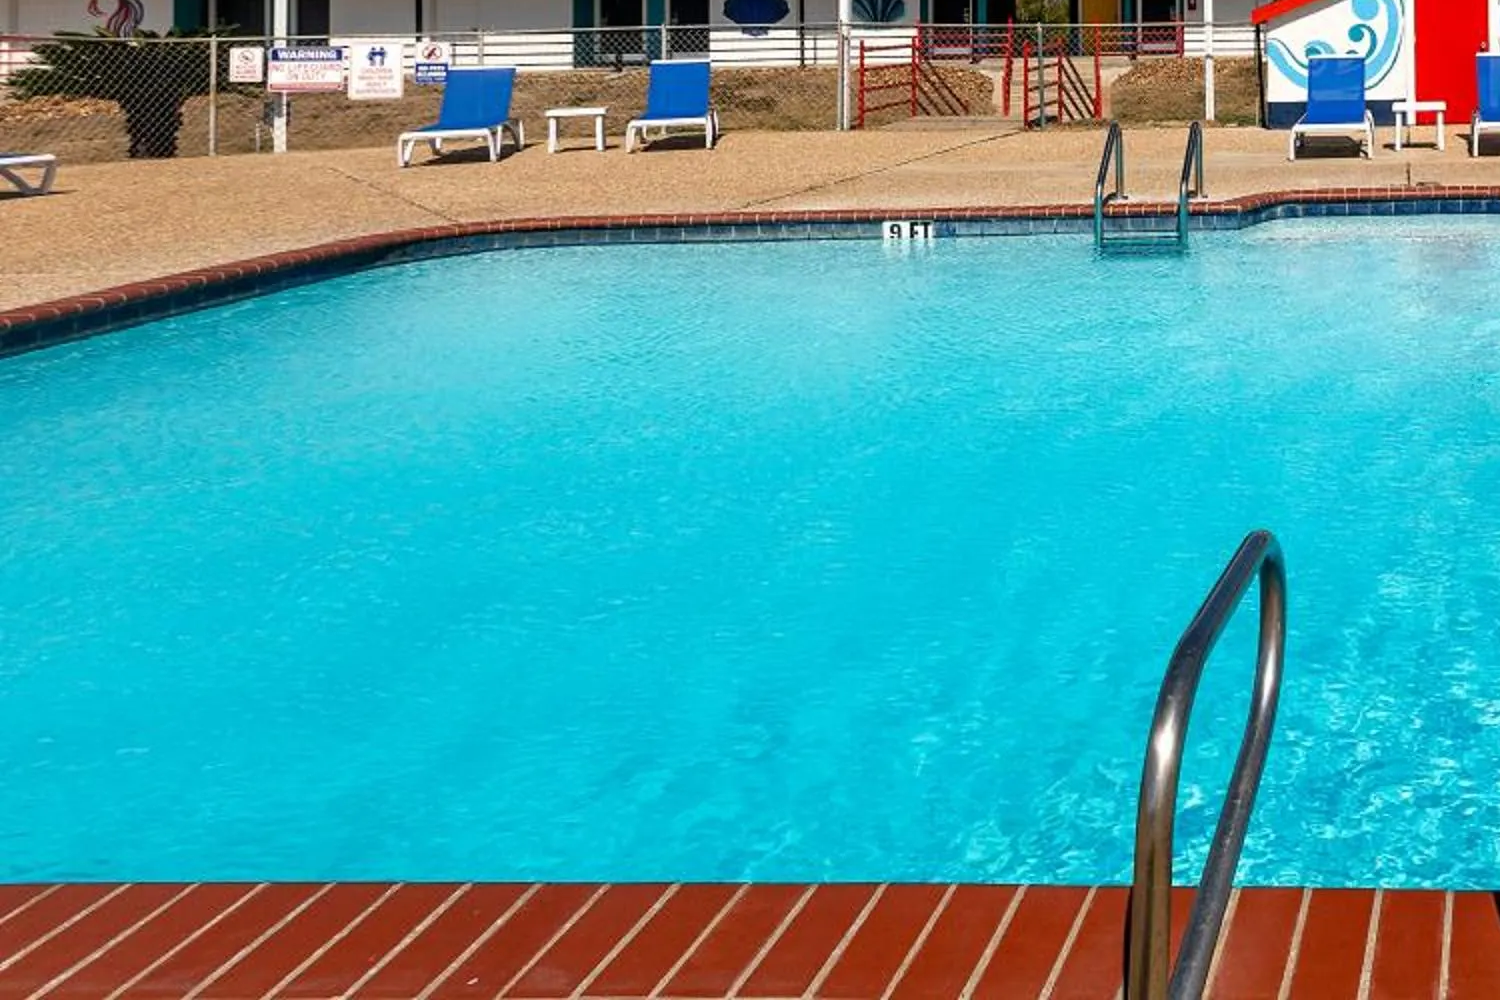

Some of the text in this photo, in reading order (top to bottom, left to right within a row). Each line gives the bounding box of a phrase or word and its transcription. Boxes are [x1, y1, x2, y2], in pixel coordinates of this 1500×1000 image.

[277, 49, 337, 59] WARNING
[287, 63, 341, 72] LIFEGUARD
[301, 71, 326, 80] DUTY
[890, 221, 930, 239] 9 FT
